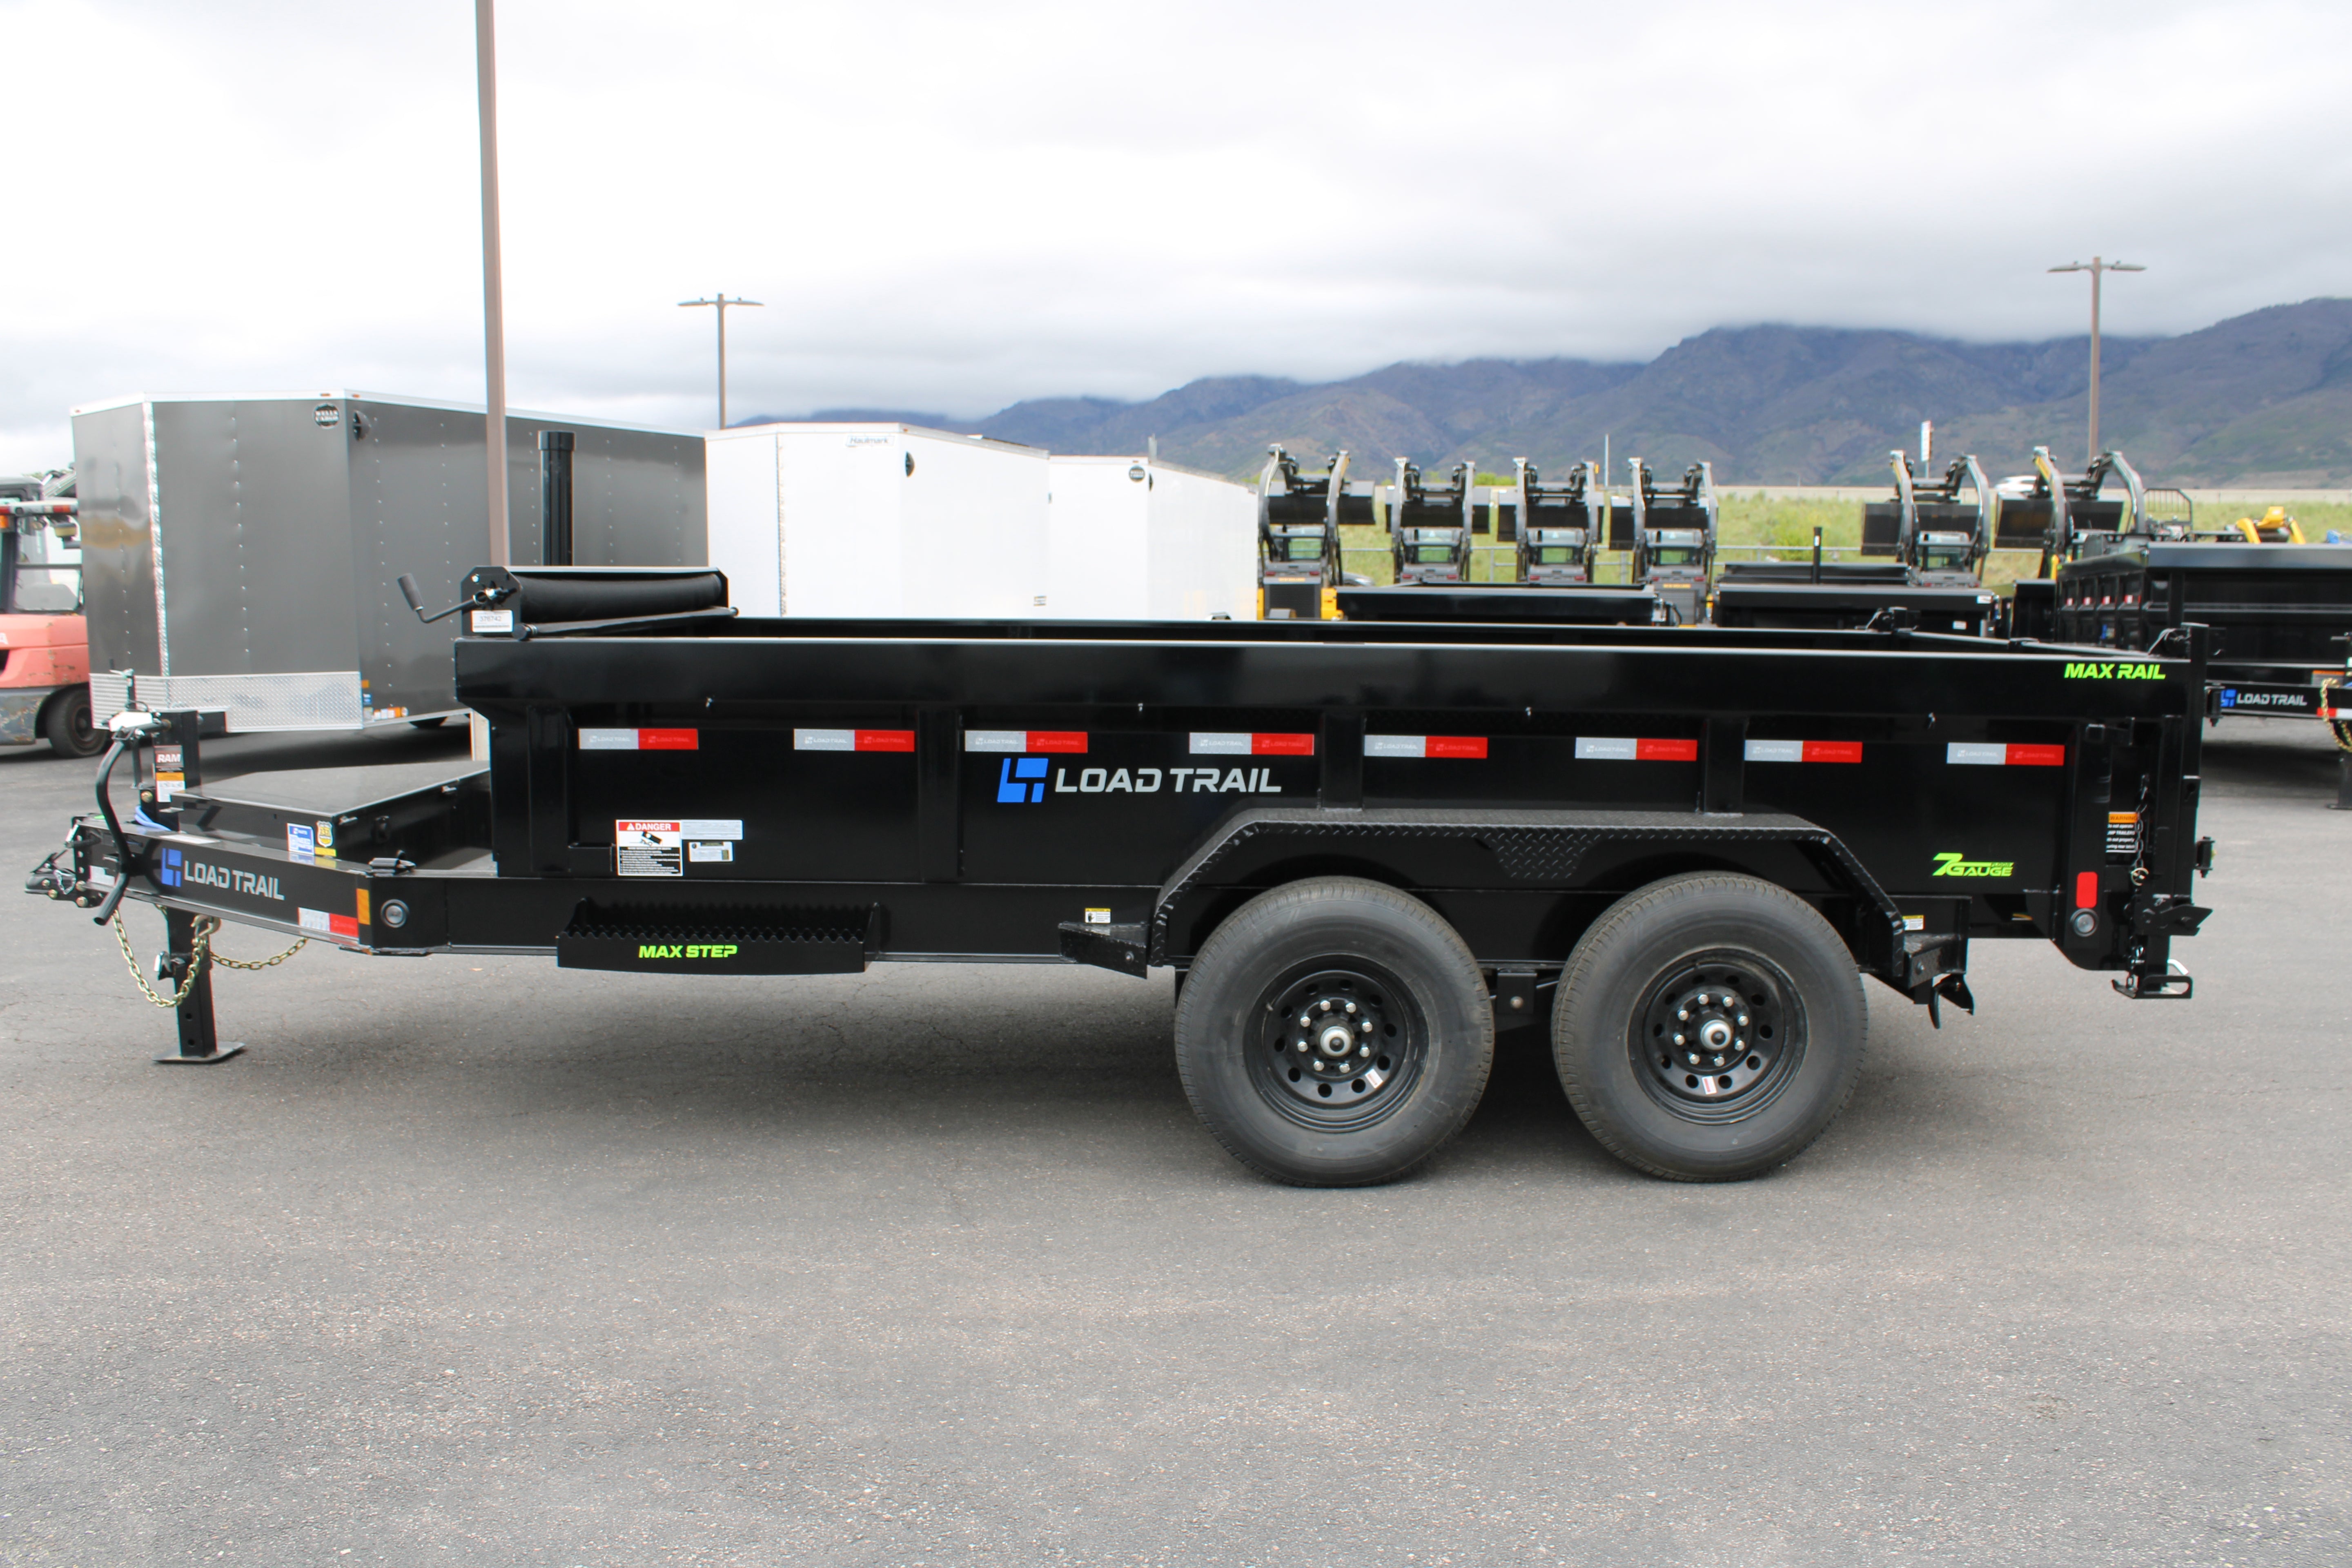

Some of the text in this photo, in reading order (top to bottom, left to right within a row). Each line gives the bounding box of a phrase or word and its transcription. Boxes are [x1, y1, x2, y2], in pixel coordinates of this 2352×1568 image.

[2064, 663, 2166, 679] MAX RAIL
[2236, 693, 2307, 706] LOAD TRAIL
[158, 753, 181, 763] RAM
[1055, 768, 1282, 793] LOAD TRAIL
[1932, 853, 1963, 876] 7
[1946, 862, 2013, 876] GAUGE
[184, 860, 285, 901] LOAD TRAIL
[639, 945, 737, 958] MAX STEP
